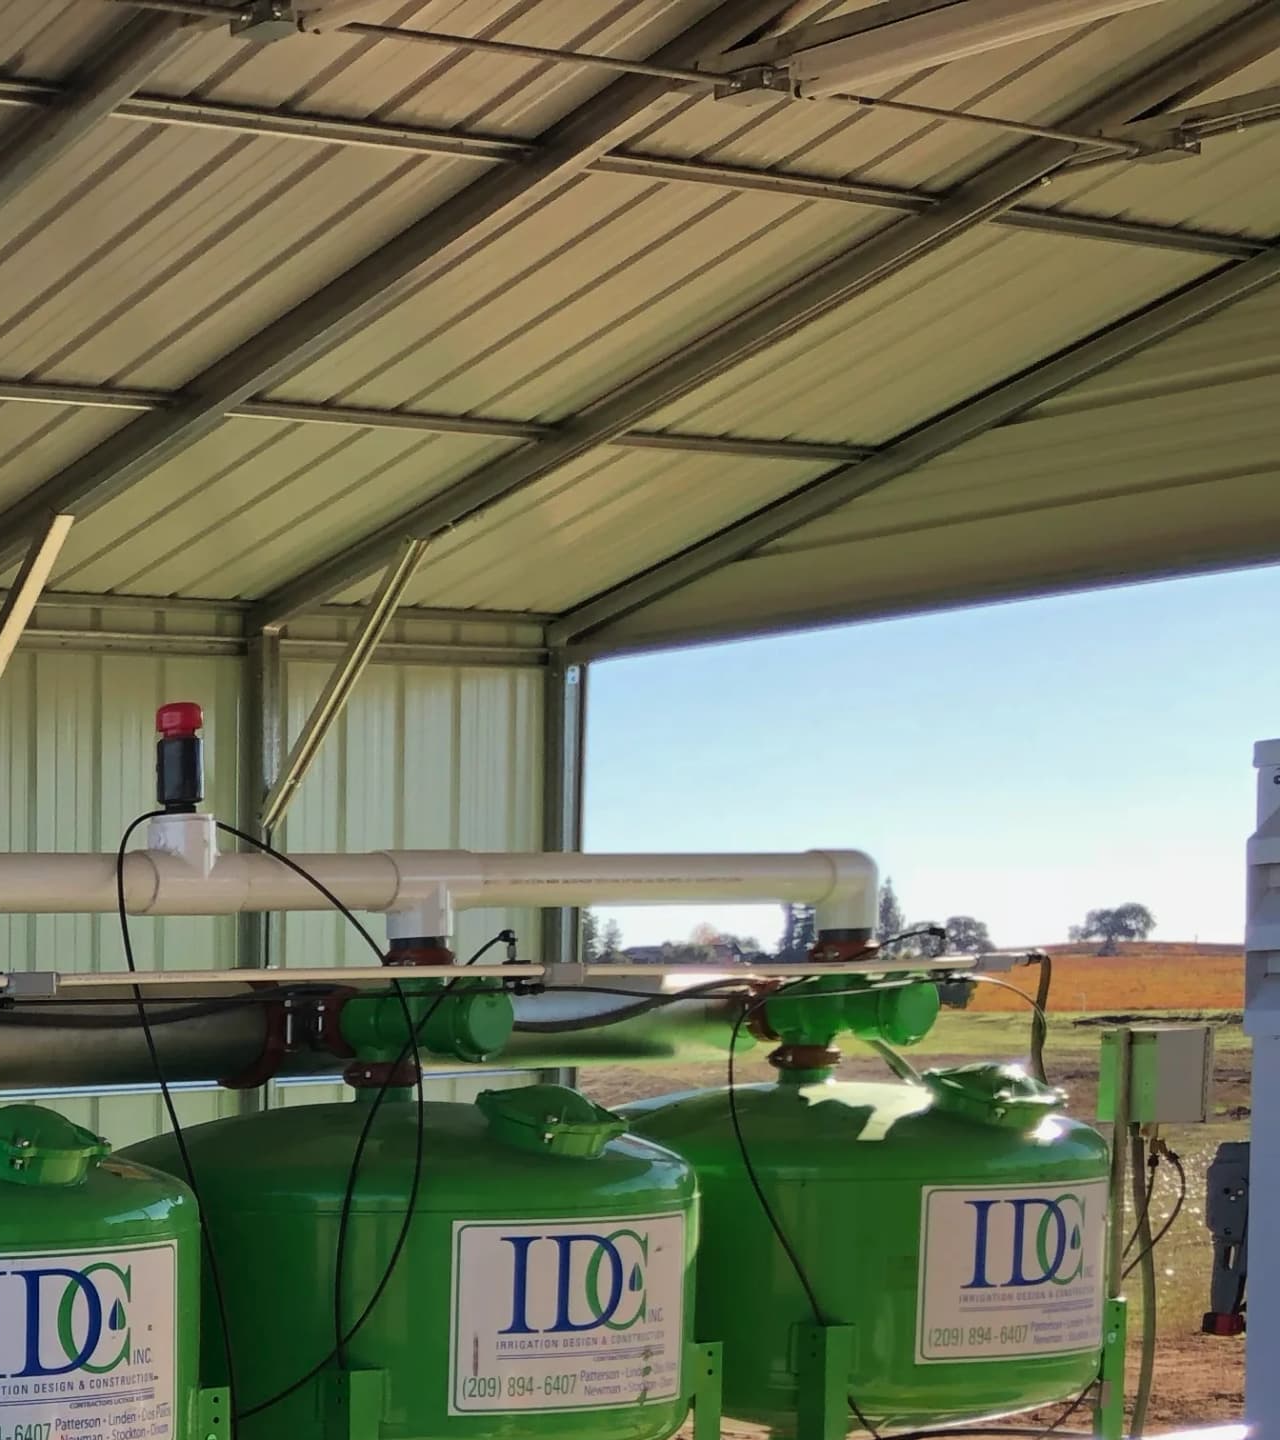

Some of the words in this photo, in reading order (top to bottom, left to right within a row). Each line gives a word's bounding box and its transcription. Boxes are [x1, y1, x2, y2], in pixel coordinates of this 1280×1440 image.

[960, 1193, 1085, 1288] IDC
[497, 1229, 648, 1334] IDC
[496, 1337, 558, 1350] IRRIGATION
[563, 1335, 598, 1348] DESIGN
[34, 1381, 74, 1394] DESIGN
[79, 1379, 85, 1390] &
[90, 1372, 154, 1389] CONSTRUCTION
[462, 1376, 502, 1400] (209)
[507, 1374, 577, 1397] 894-6407
[55, 1417, 101, 1431] Patterson
[108, 1411, 136, 1426] Linden
